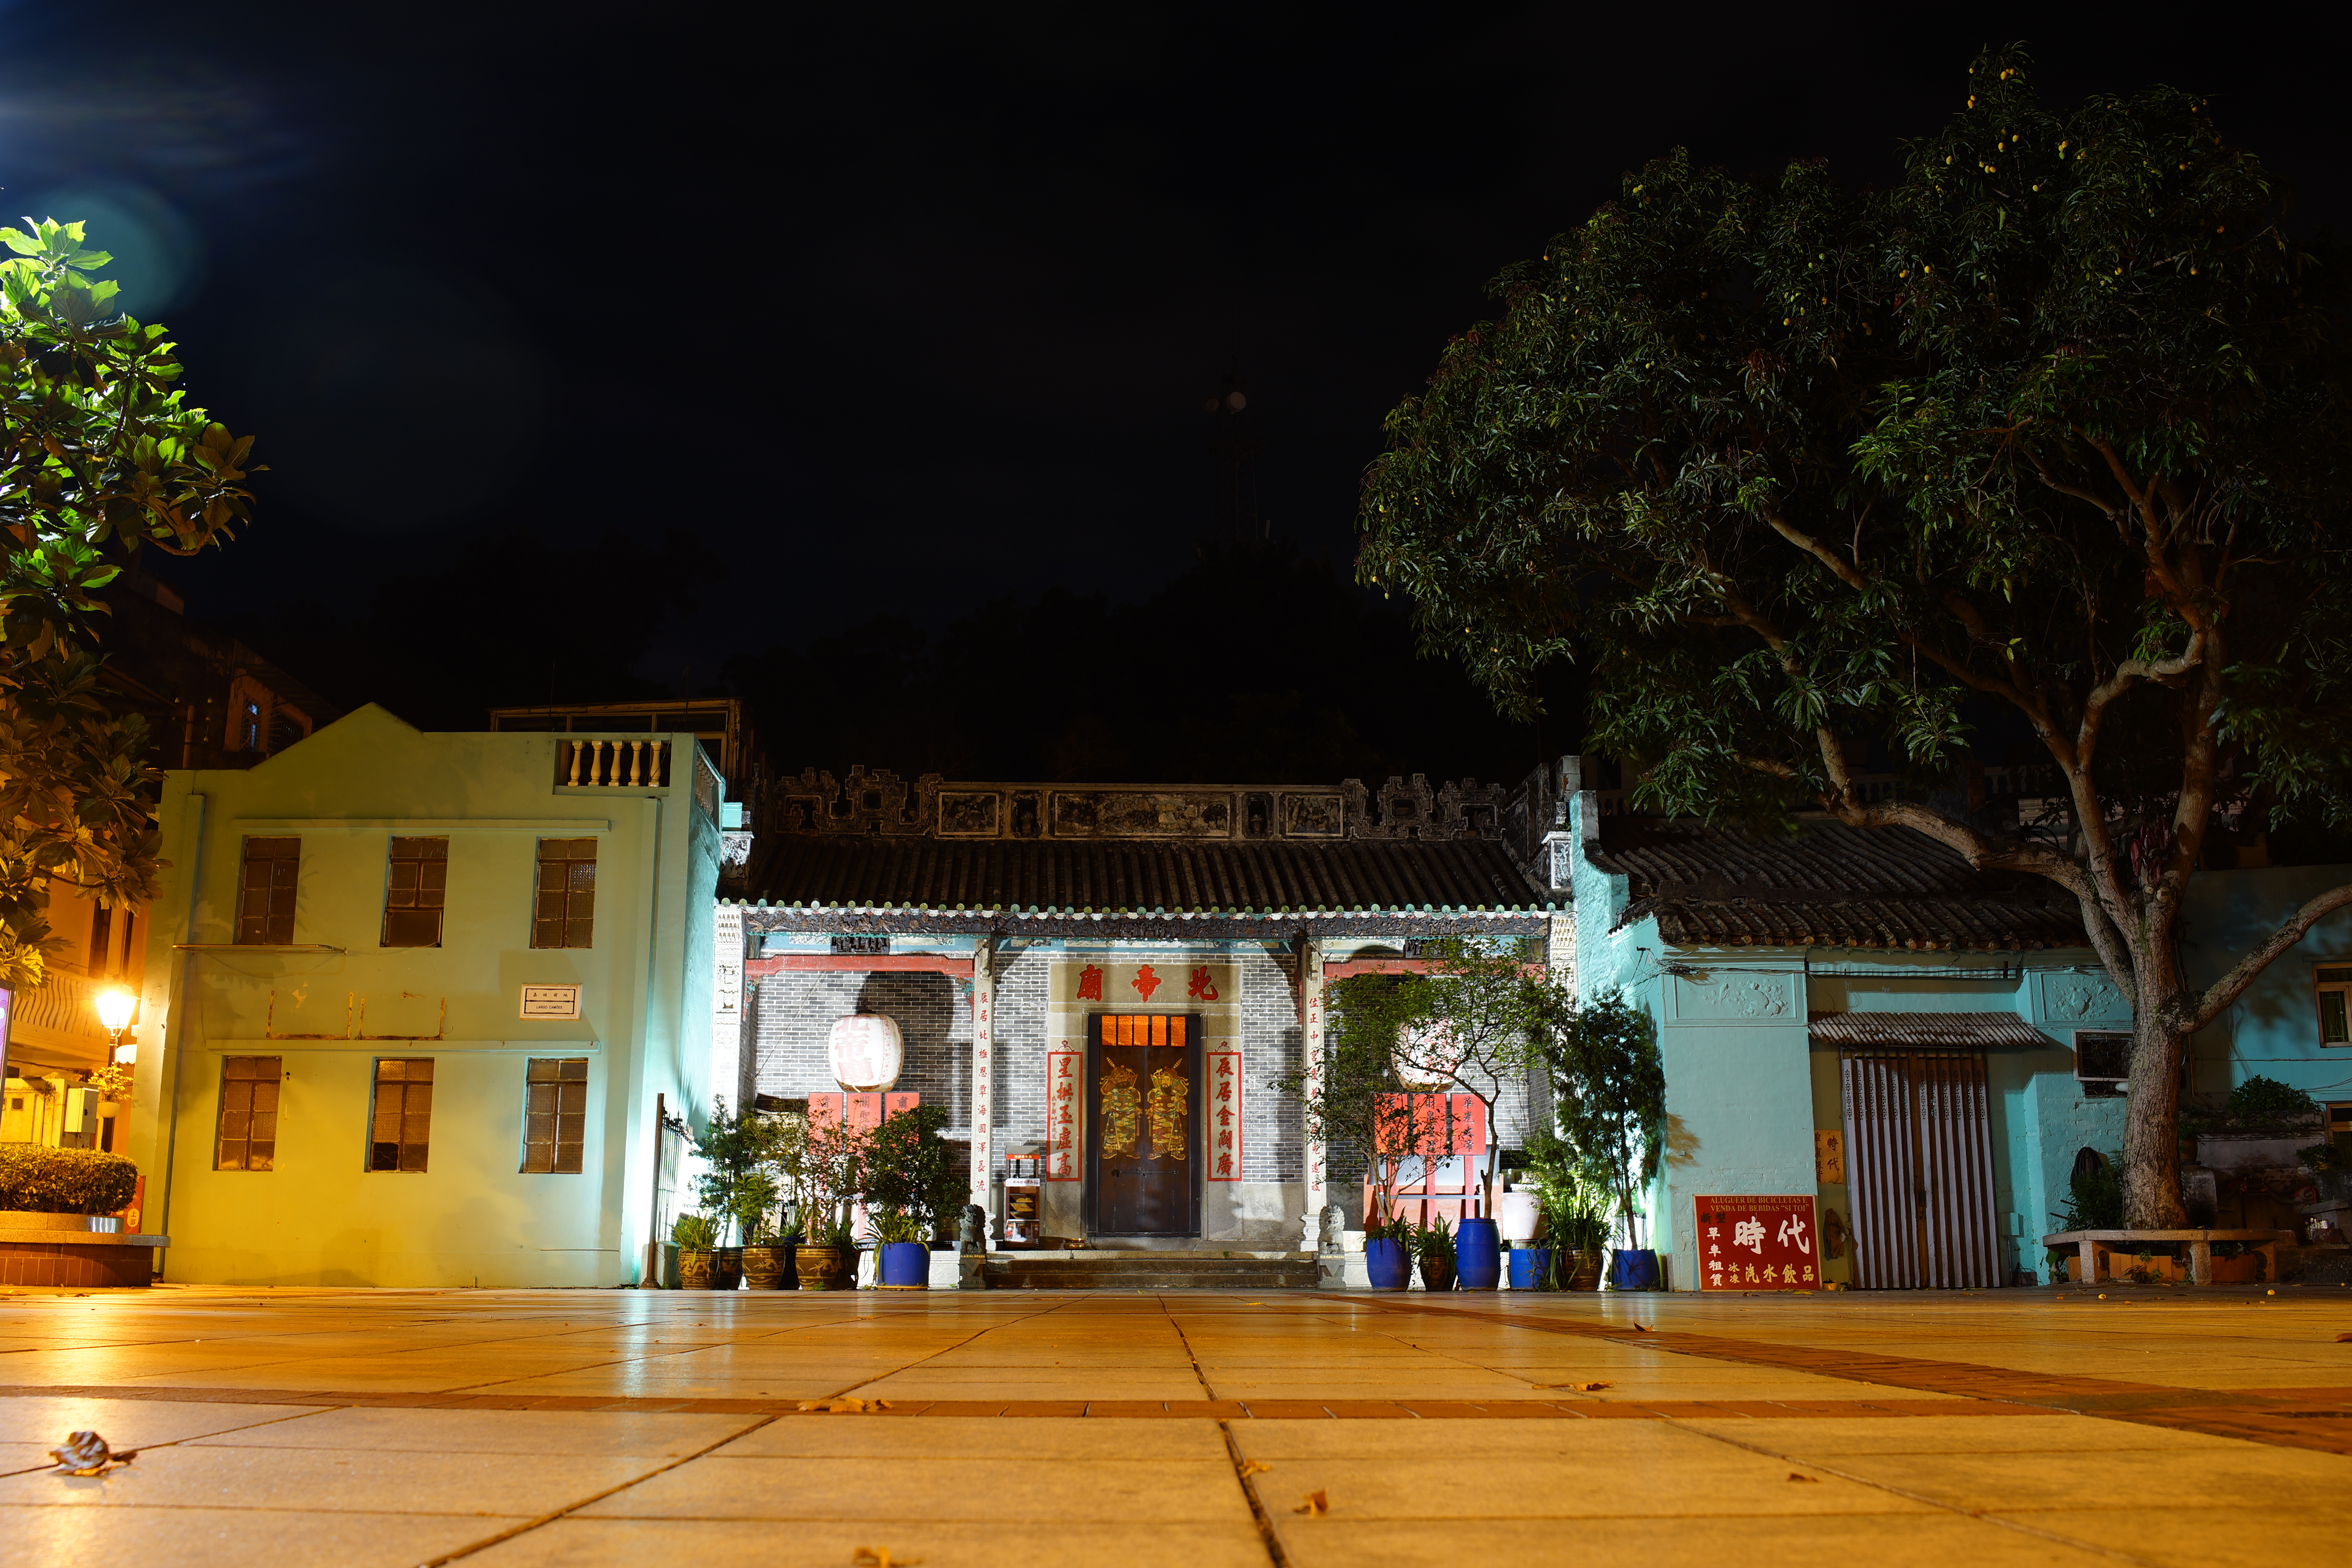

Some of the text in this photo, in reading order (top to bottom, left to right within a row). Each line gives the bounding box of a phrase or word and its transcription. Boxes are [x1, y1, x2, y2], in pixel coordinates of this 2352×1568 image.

[1077, 964, 1218, 1002] 北帝廟
[835, 1014, 874, 1083] 北帝廟
[1827, 1135, 1839, 1171] 時代
[130, 1210, 136, 1225] 士多
[1733, 1214, 1809, 1254] 時代
[1707, 1227, 1724, 1286] 單車租賃
[1746, 1263, 1814, 1283] 汽水飲品
